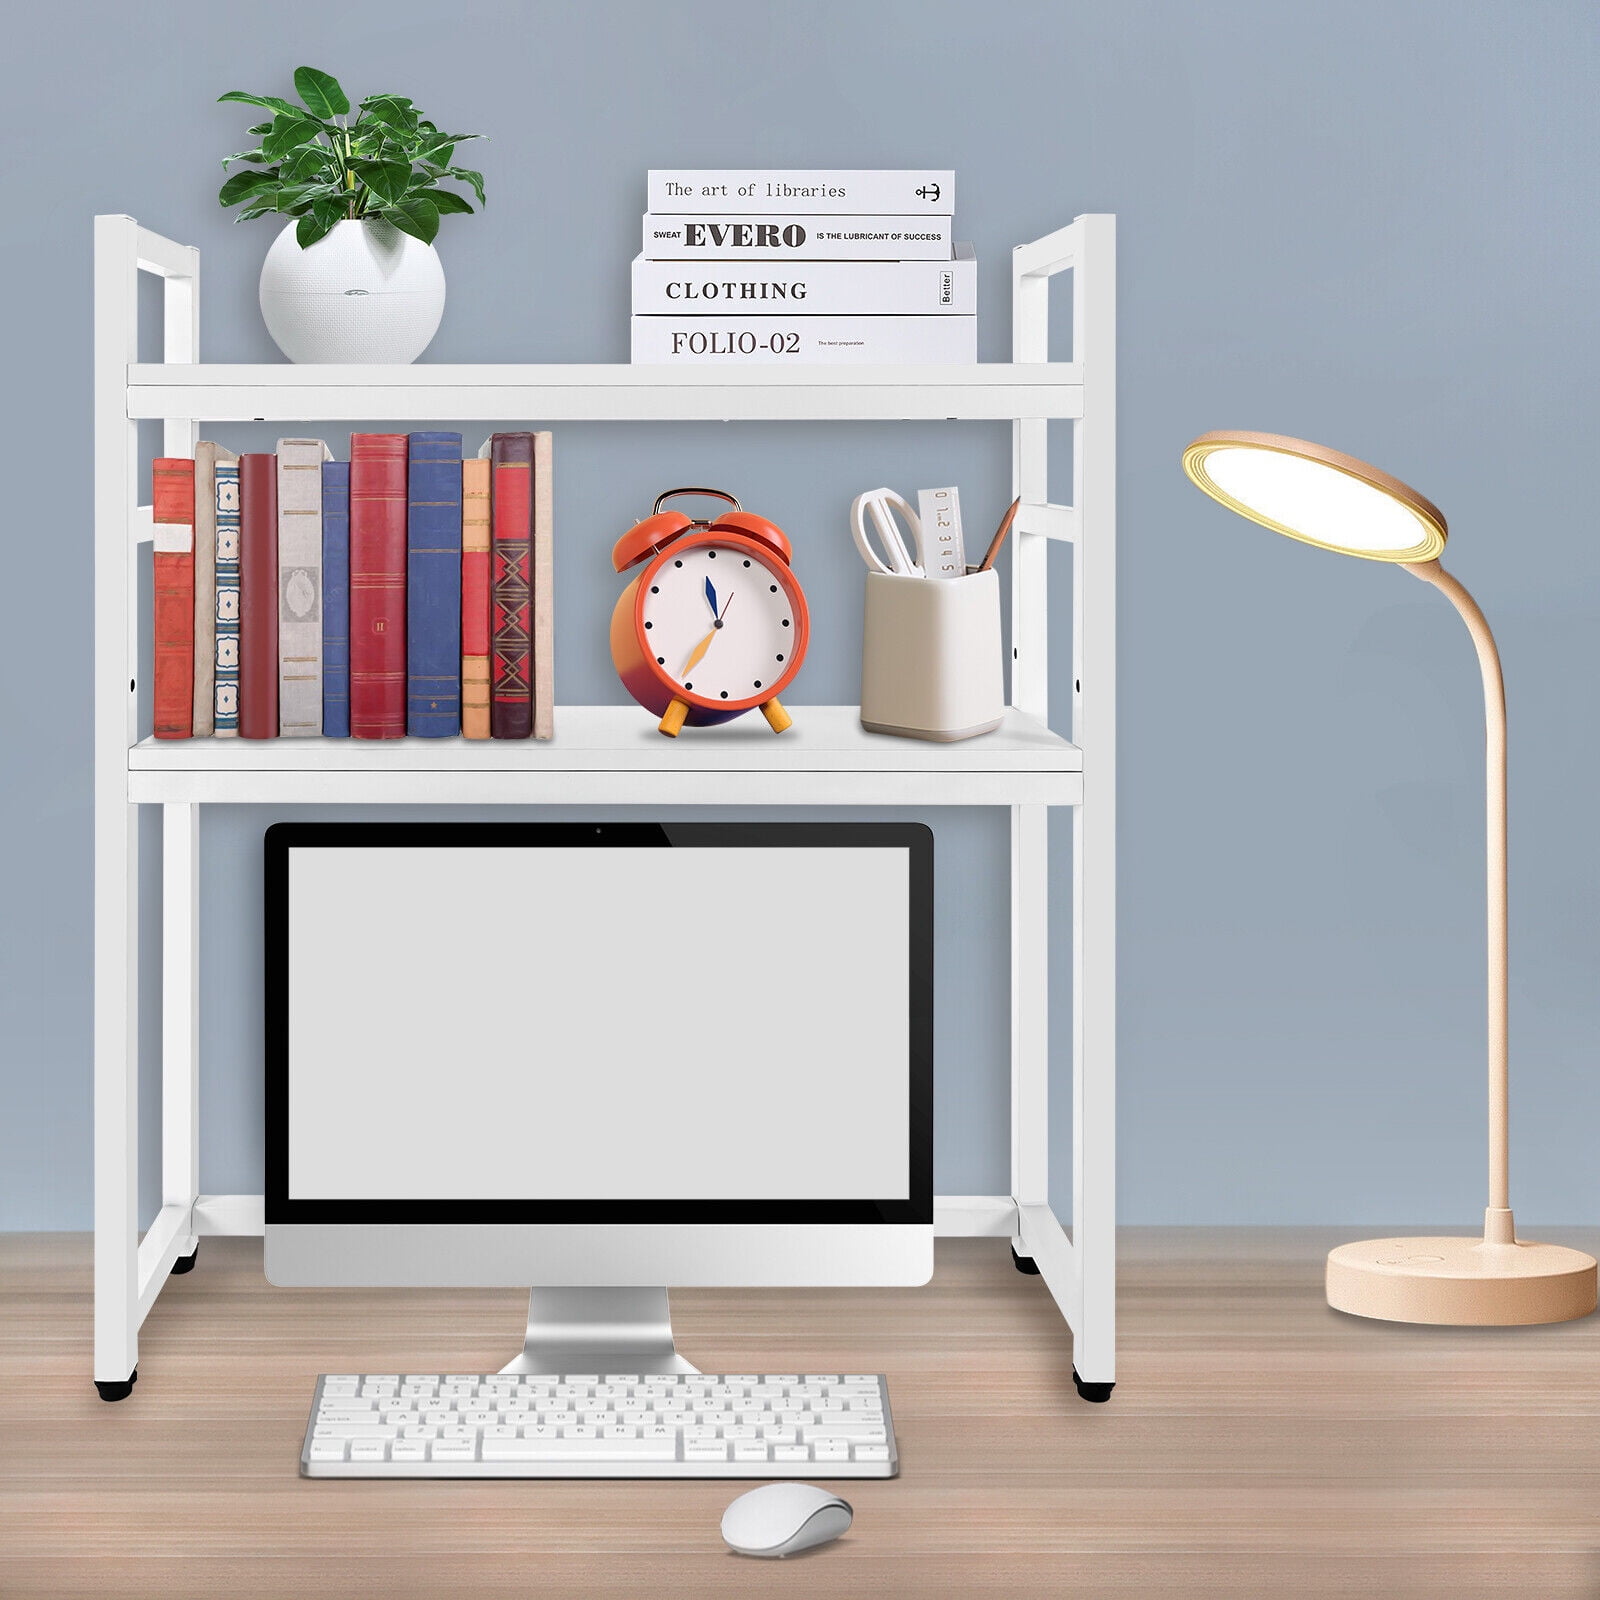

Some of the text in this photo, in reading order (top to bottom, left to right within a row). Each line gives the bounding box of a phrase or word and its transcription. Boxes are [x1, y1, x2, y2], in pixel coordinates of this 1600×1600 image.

[665, 182, 846, 198] The art of libraries
[653, 223, 942, 248] SWEAT EVERO IS THE LUBRICANT OF SUCCESS
[665, 282, 808, 300] CLOTHING
[942, 273, 951, 303] Better
[671, 331, 801, 355] FOLIO-02
